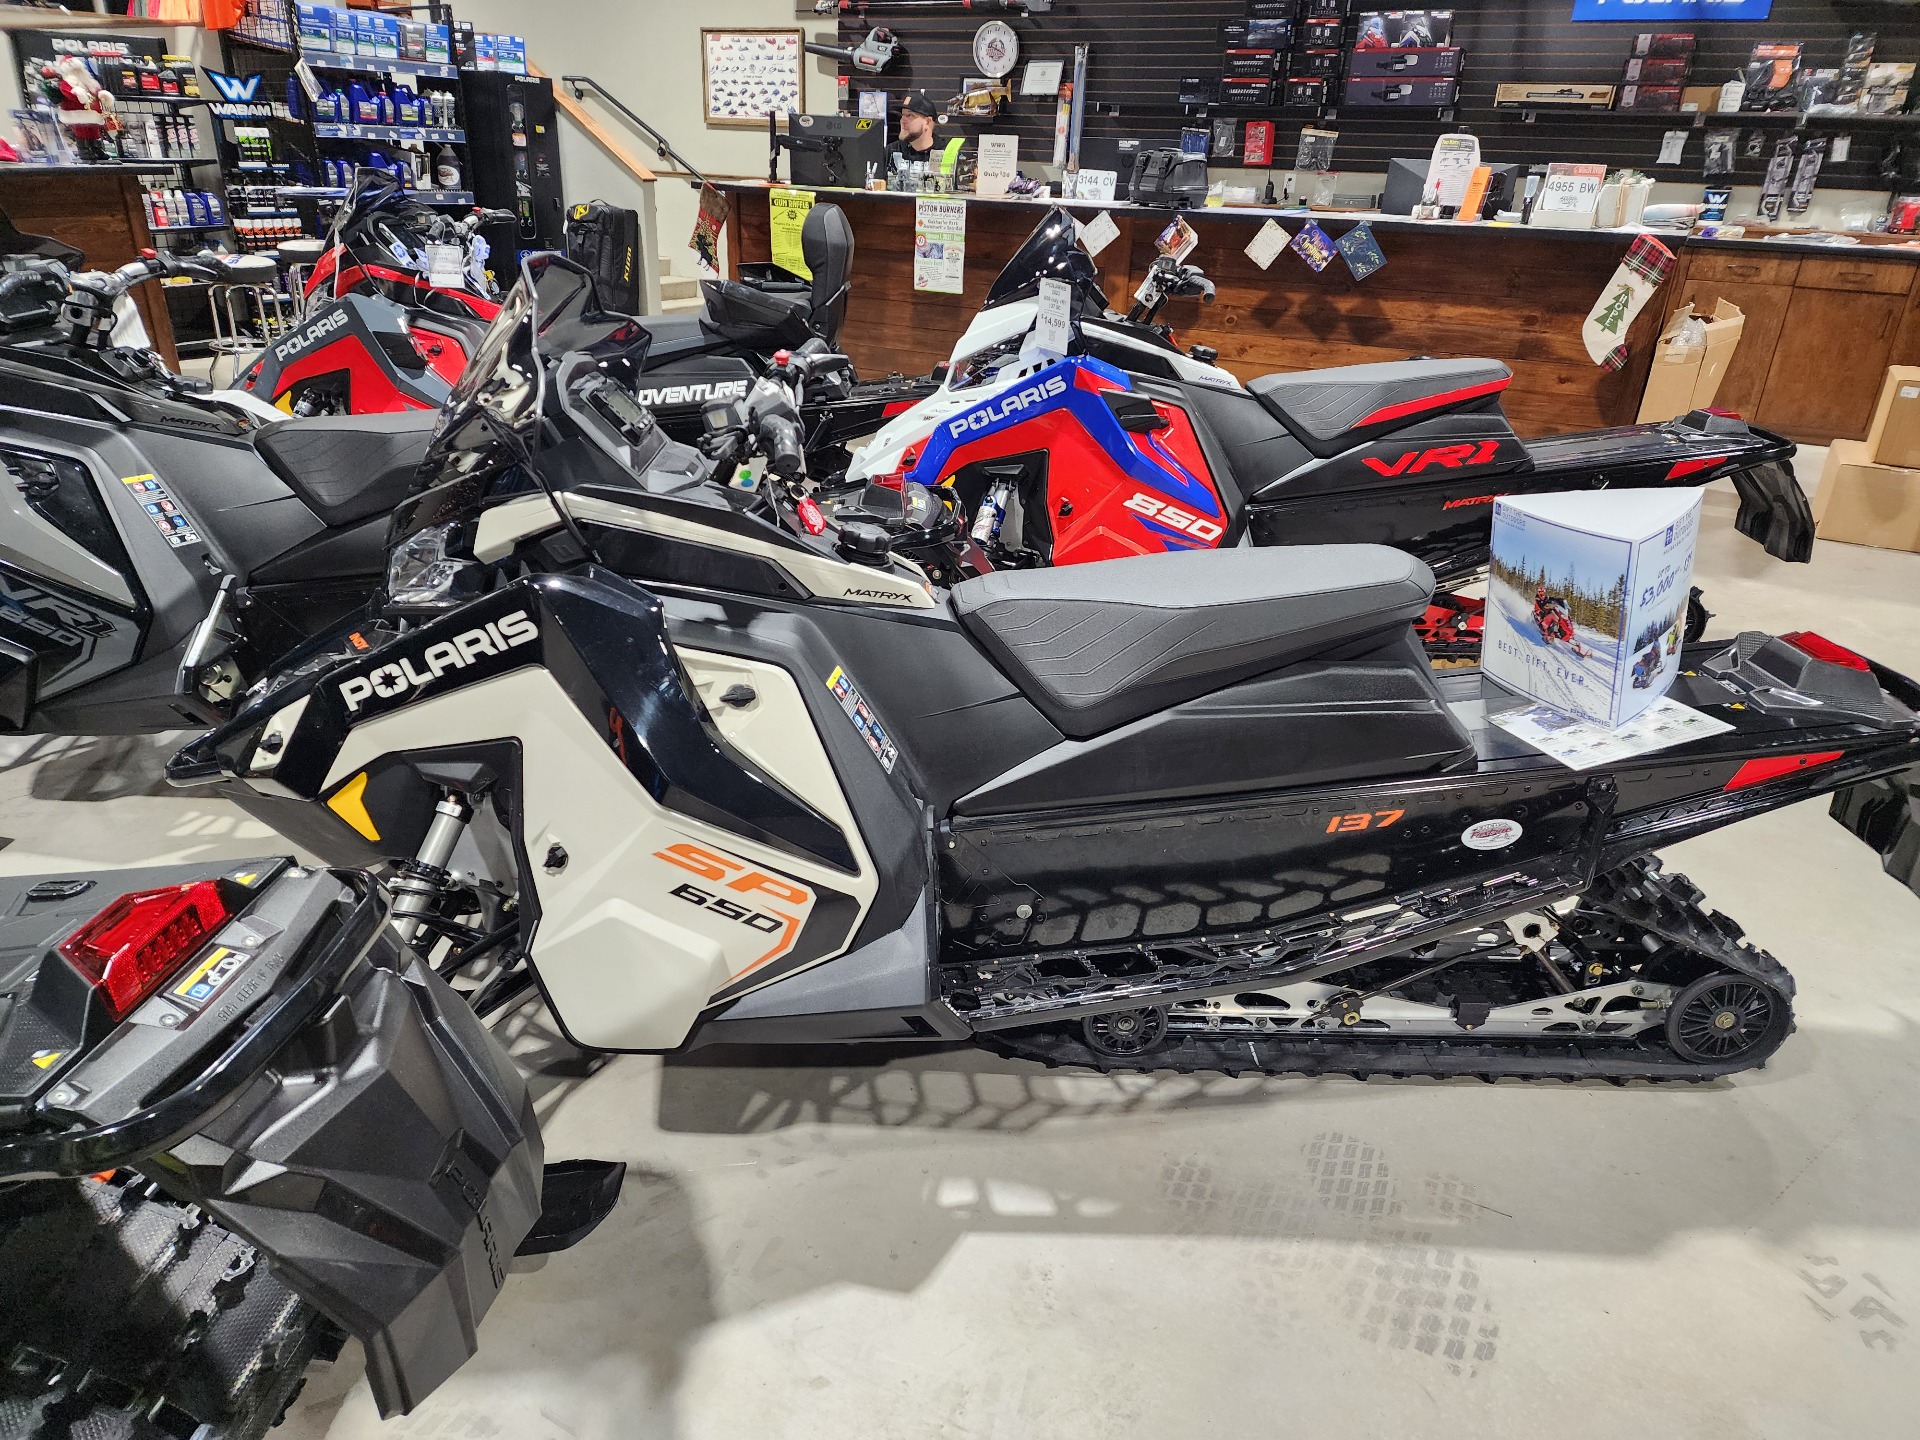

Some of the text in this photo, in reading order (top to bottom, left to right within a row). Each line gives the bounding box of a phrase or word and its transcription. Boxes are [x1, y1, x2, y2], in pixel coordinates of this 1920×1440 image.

[52, 38, 128, 52] POLARIS
[208, 102, 272, 116] WABAM
[1079, 174, 1115, 186] 3144 CV
[1549, 181, 1597, 193] 4955 BW
[919, 205, 964, 214] PISTON BURNERS
[1045, 281, 1067, 292] POLARIS
[1605, 293, 1628, 327] HOPE
[275, 308, 349, 361] POLARIS
[948, 375, 1067, 439] POLARIS
[160, 415, 221, 431] MATRYX
[1361, 441, 1500, 477] VR1
[1442, 492, 1510, 511] MATR
[1122, 492, 1223, 541] 850
[843, 588, 913, 603] MATRYX
[1640, 571, 1675, 607] $3,000
[339, 610, 539, 712] POLARIS
[1570, 708, 1611, 728] POLARIS
[1325, 809, 1405, 834] 137
[651, 843, 808, 905] SP
[668, 883, 783, 933] 650
[217, 1001, 238, 1022] STAY
[235, 978, 260, 1002] CLEAR
